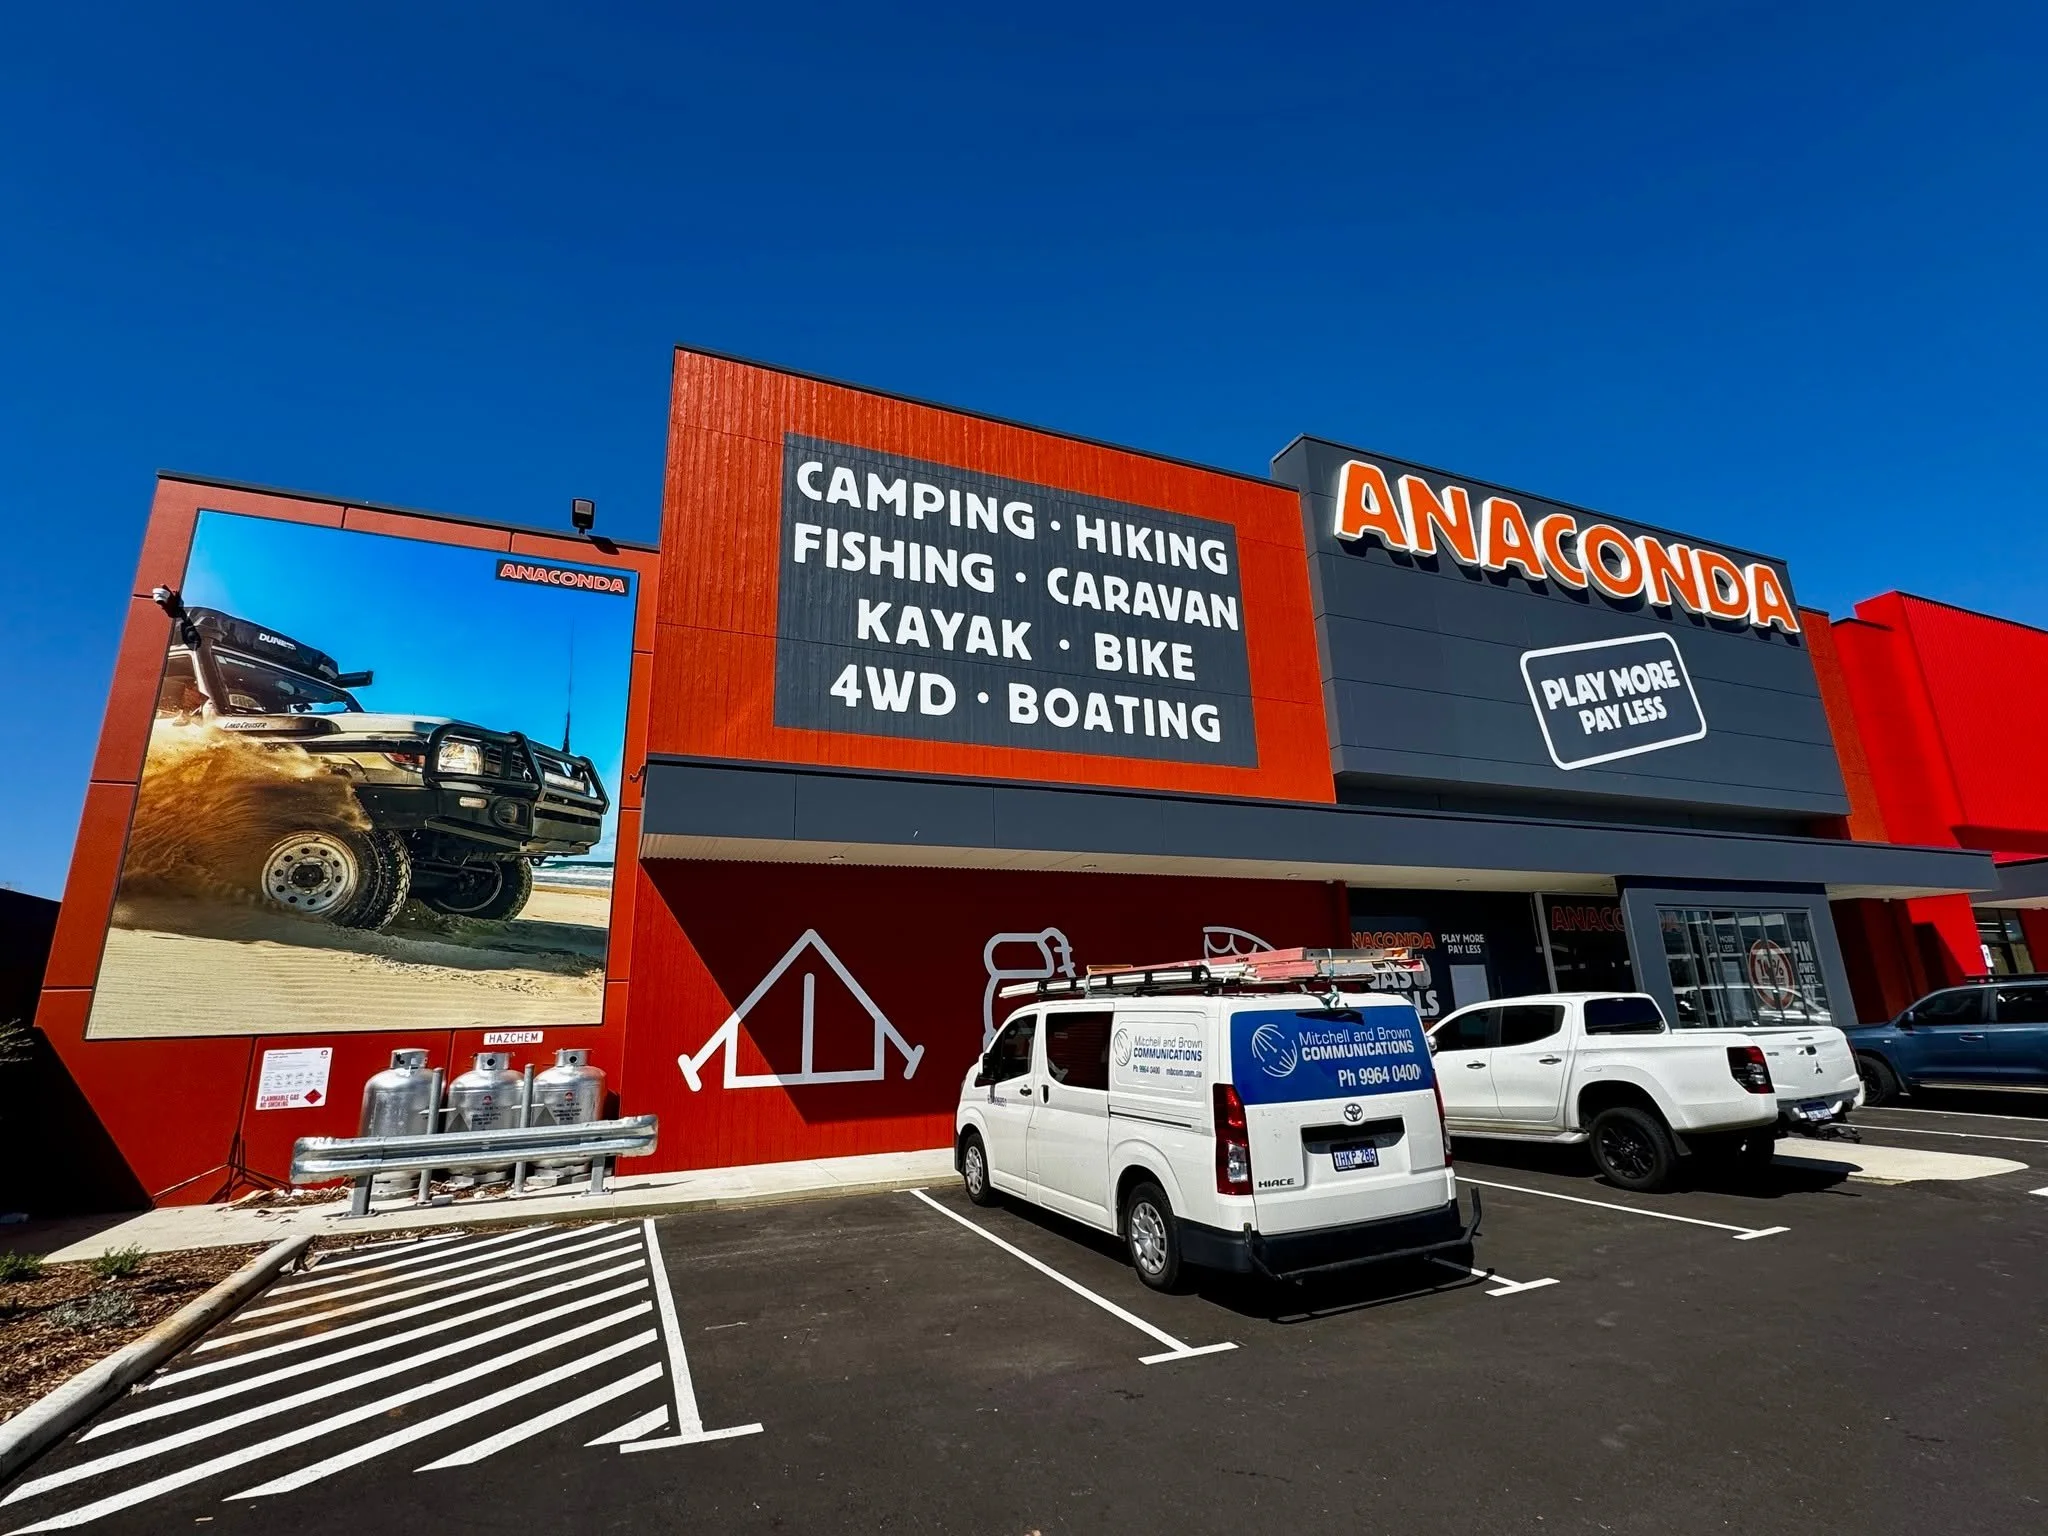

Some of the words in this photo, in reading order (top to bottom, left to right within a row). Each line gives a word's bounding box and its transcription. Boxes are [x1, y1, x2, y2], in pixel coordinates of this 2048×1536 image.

[796, 461, 1035, 540] CAMPING
[1076, 513, 1229, 576] HIKING
[1333, 459, 1801, 634] ANACONDA
[500, 563, 626, 593] ANACONDA
[794, 522, 995, 594] FISHING
[1046, 567, 1240, 631] CARAVAN
[857, 598, 1033, 661] KAYAK
[1094, 632, 1196, 682] BIKE
[1541, 671, 1608, 711] PLAY
[1608, 660, 1681, 698] MORE
[830, 663, 957, 717] 4WD
[1008, 682, 1222, 743] BOATING
[1578, 703, 1622, 735] PAY
[1623, 696, 1668, 726] LESS
[1352, 931, 1436, 950] NACONDA
[1441, 933, 1461, 943] PLAY
[1463, 933, 1485, 943] MORE
[1447, 944, 1463, 954] PAY
[1465, 944, 1482, 954] LESS
[488, 1032, 539, 1044] HAZCHEM
[1134, 1035, 1161, 1047] Mitchell
[1162, 1036, 1177, 1048] and
[1178, 1036, 1203, 1049] Brown
[1298, 1028, 1351, 1047] Mitchell
[1353, 1027, 1375, 1043] and
[1377, 1026, 1412, 1041] Brown
[1133, 1047, 1203, 1062] COMMUNICATIONS
[1301, 1039, 1415, 1062] COMMUNICATIONS
[1337, 1069, 1357, 1088] Ph
[1358, 1065, 1390, 1086] 9964
[1391, 1063, 1420, 1083] 0400
[1258, 1177, 1295, 1188] HIACE
